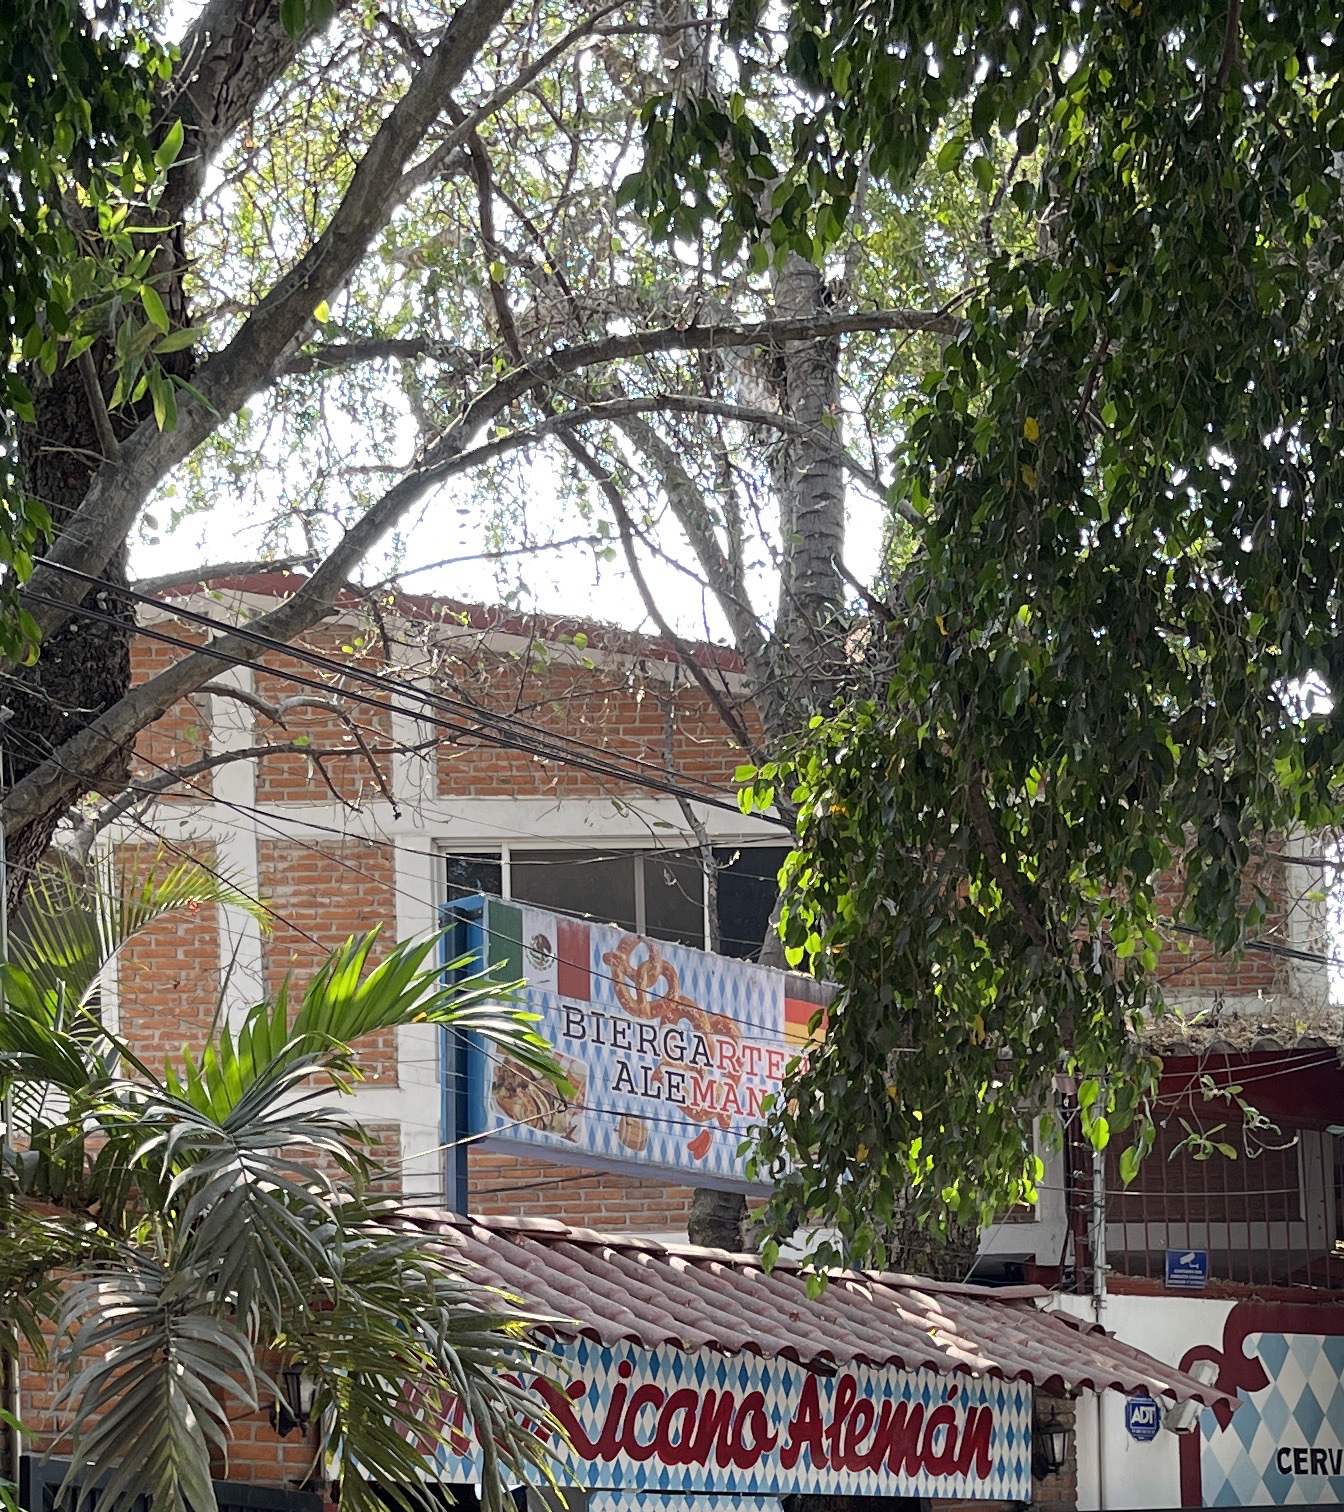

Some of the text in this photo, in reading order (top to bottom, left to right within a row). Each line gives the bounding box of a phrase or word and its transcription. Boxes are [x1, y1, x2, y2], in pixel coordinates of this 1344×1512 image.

[612, 1059, 768, 1120] ALEMAN
[780, 1372, 994, 1481] Alemán
[1131, 1406, 1155, 1424] ADT
